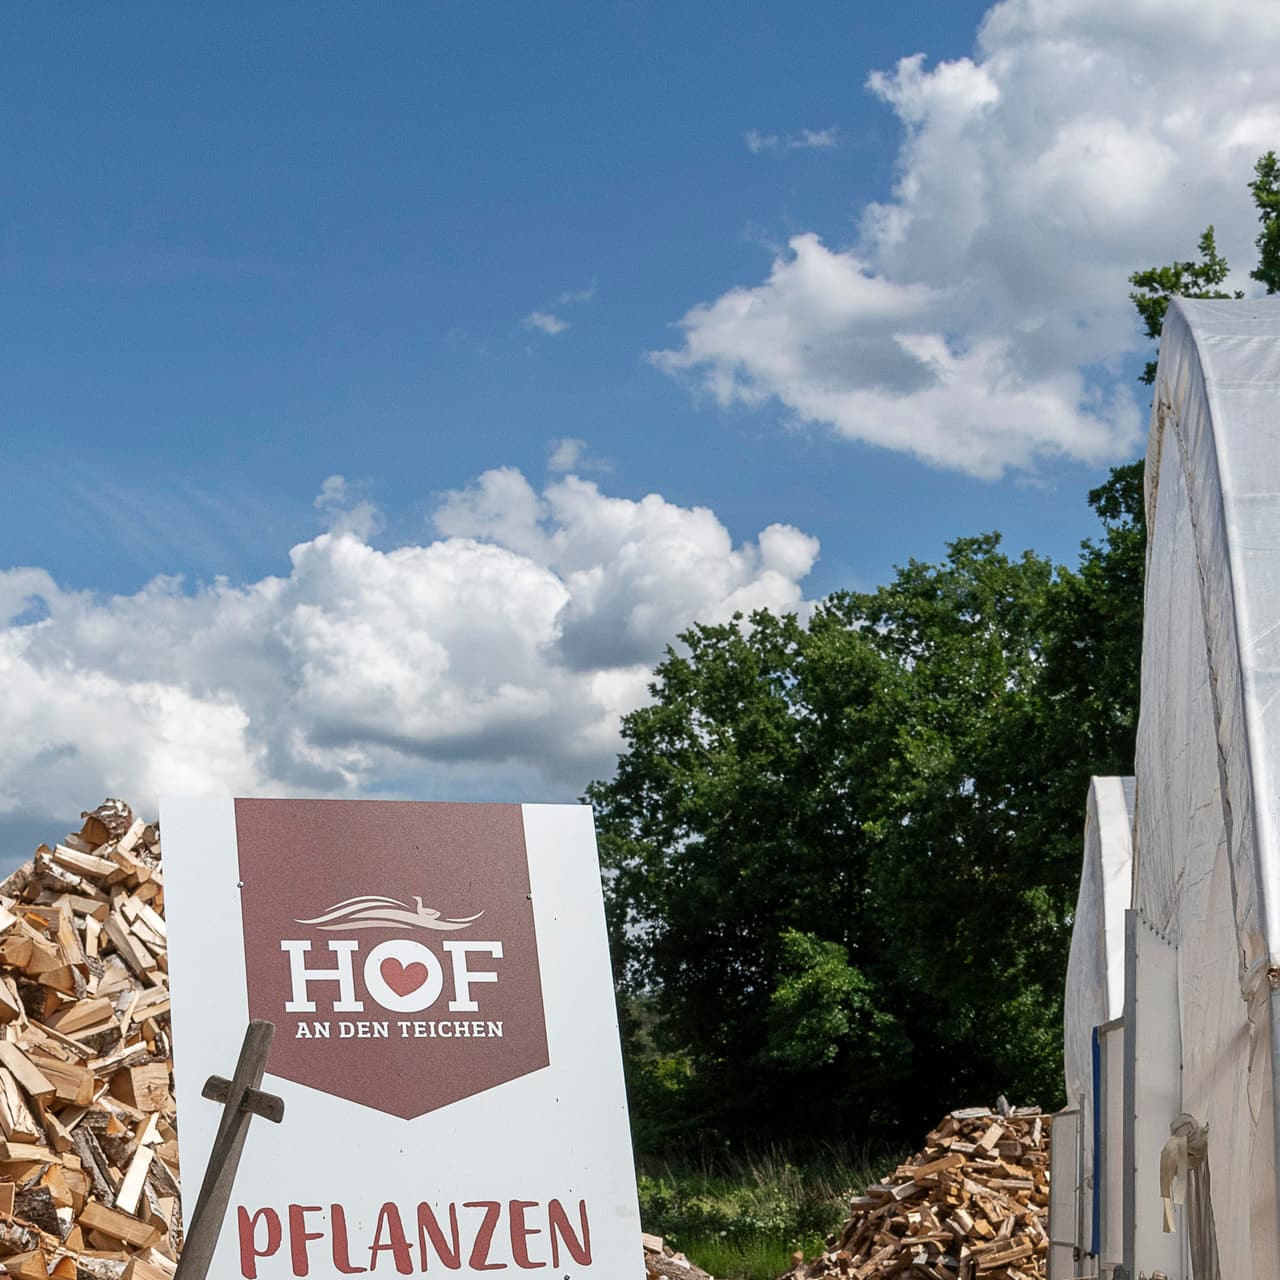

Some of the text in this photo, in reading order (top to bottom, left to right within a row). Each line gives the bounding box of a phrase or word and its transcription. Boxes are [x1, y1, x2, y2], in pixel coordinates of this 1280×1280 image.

[280, 939, 504, 1013] HOF
[295, 1020, 504, 1039] AN DEN TEICHEN
[237, 1199, 592, 1280] PFLANZEN
